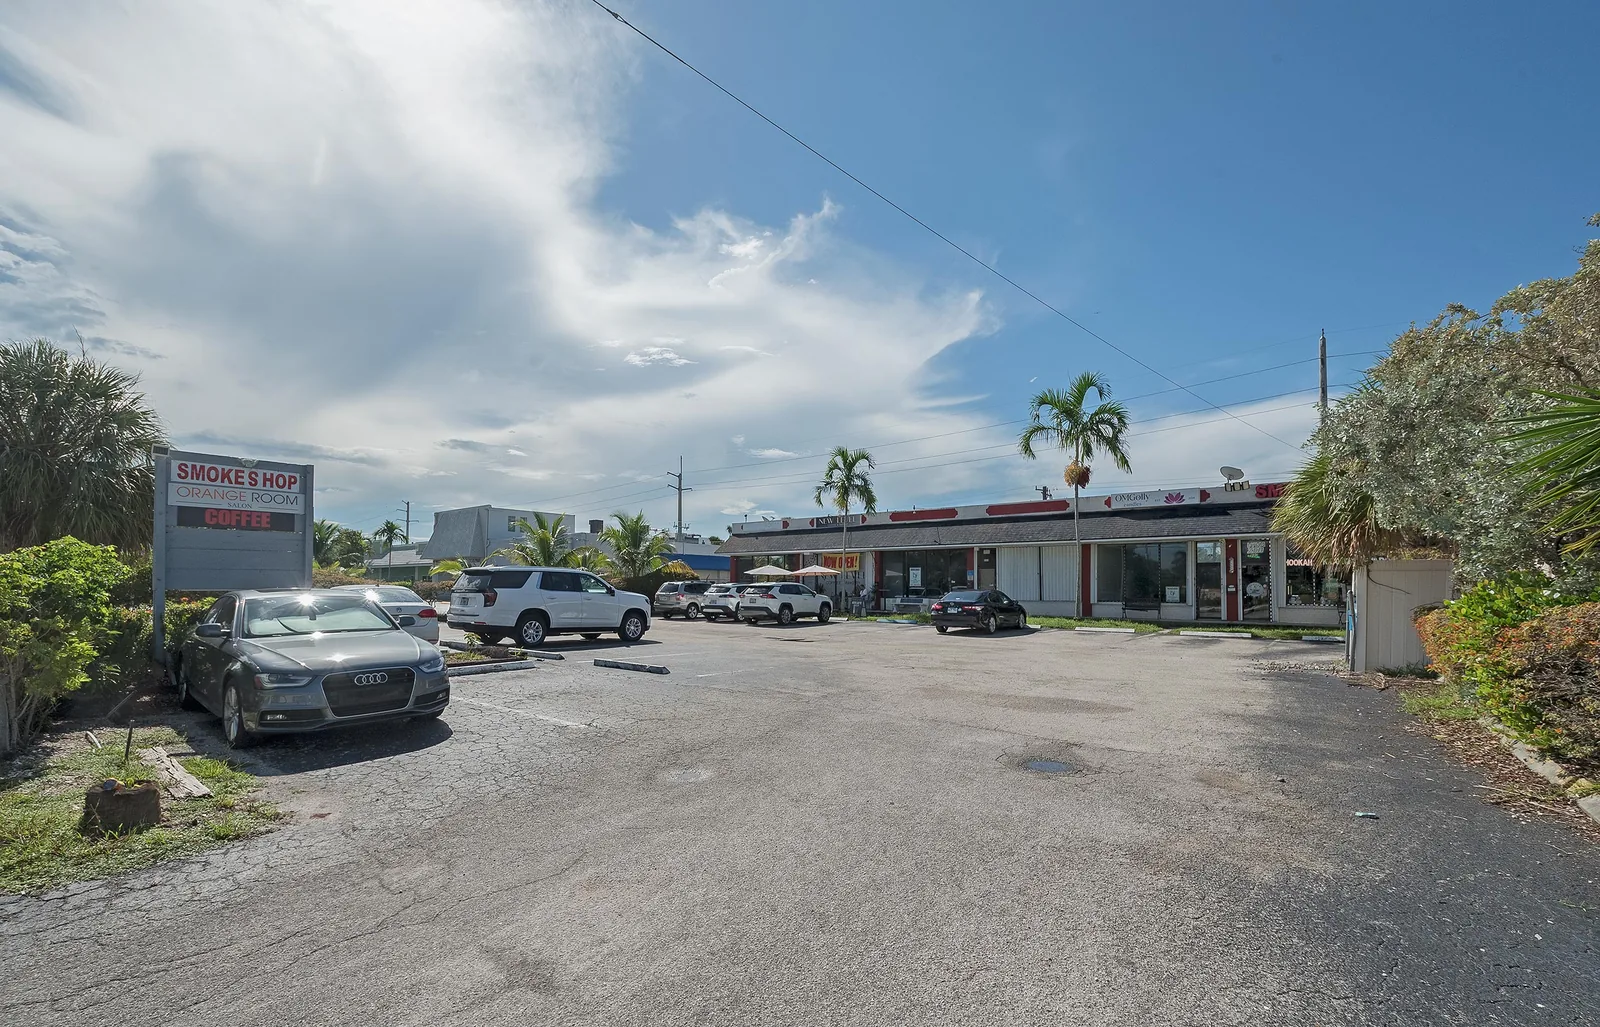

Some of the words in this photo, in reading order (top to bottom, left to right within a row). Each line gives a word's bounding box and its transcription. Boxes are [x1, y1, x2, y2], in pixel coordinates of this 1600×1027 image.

[177, 463, 244, 485] SMOKE
[248, 471, 297, 490] SHOP
[176, 486, 247, 501] ORANGE
[252, 492, 298, 505] ROOM
[1115, 492, 1150, 502] OMGolly
[204, 509, 271, 528] COFFEE
[823, 556, 837, 568] NOW
[838, 556, 858, 568] OEN!
[1286, 559, 1313, 567] HOOKAH
